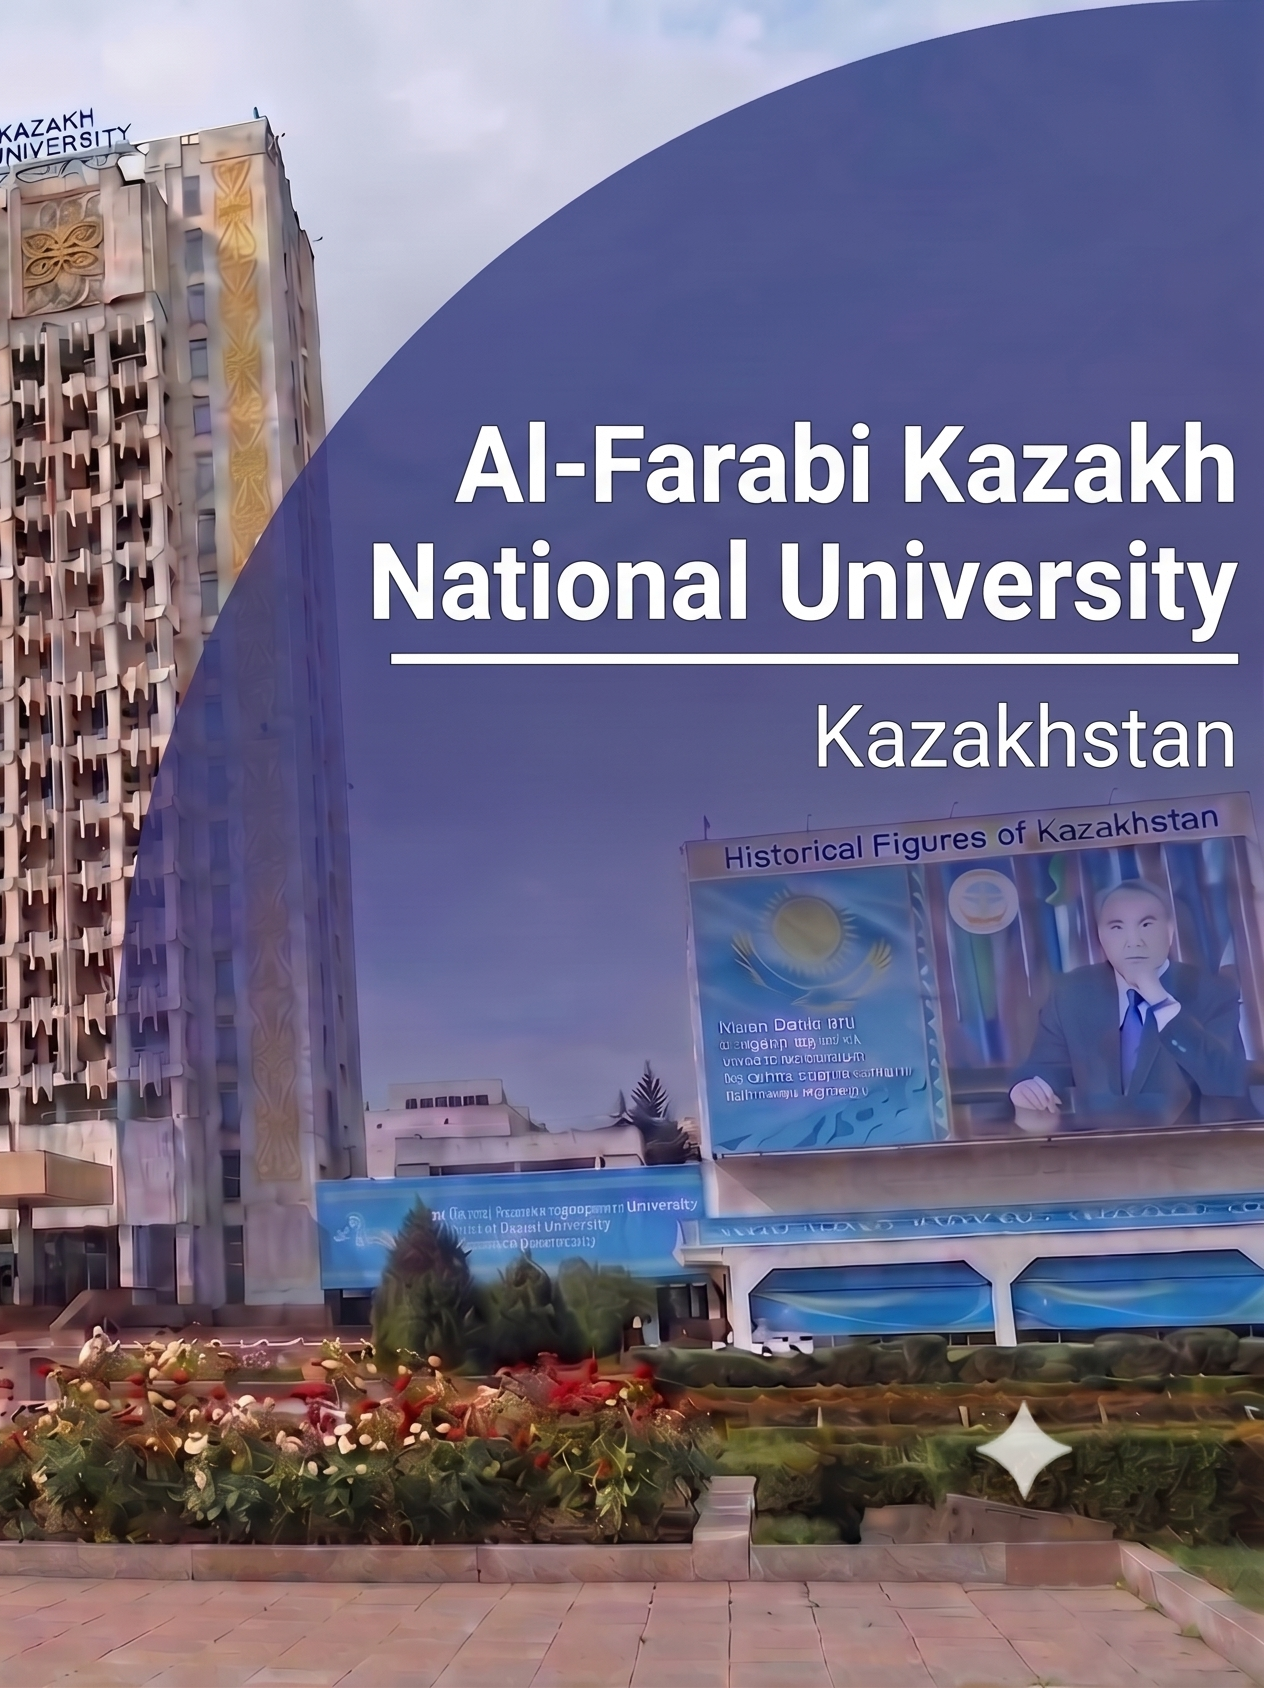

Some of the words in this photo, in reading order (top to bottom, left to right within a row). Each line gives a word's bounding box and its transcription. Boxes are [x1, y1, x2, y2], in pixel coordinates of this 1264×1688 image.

[724, 834, 863, 871] Historical
[872, 828, 988, 863] Figures
[997, 820, 1028, 847] of
[1036, 807, 1220, 844] Kazakhstan
